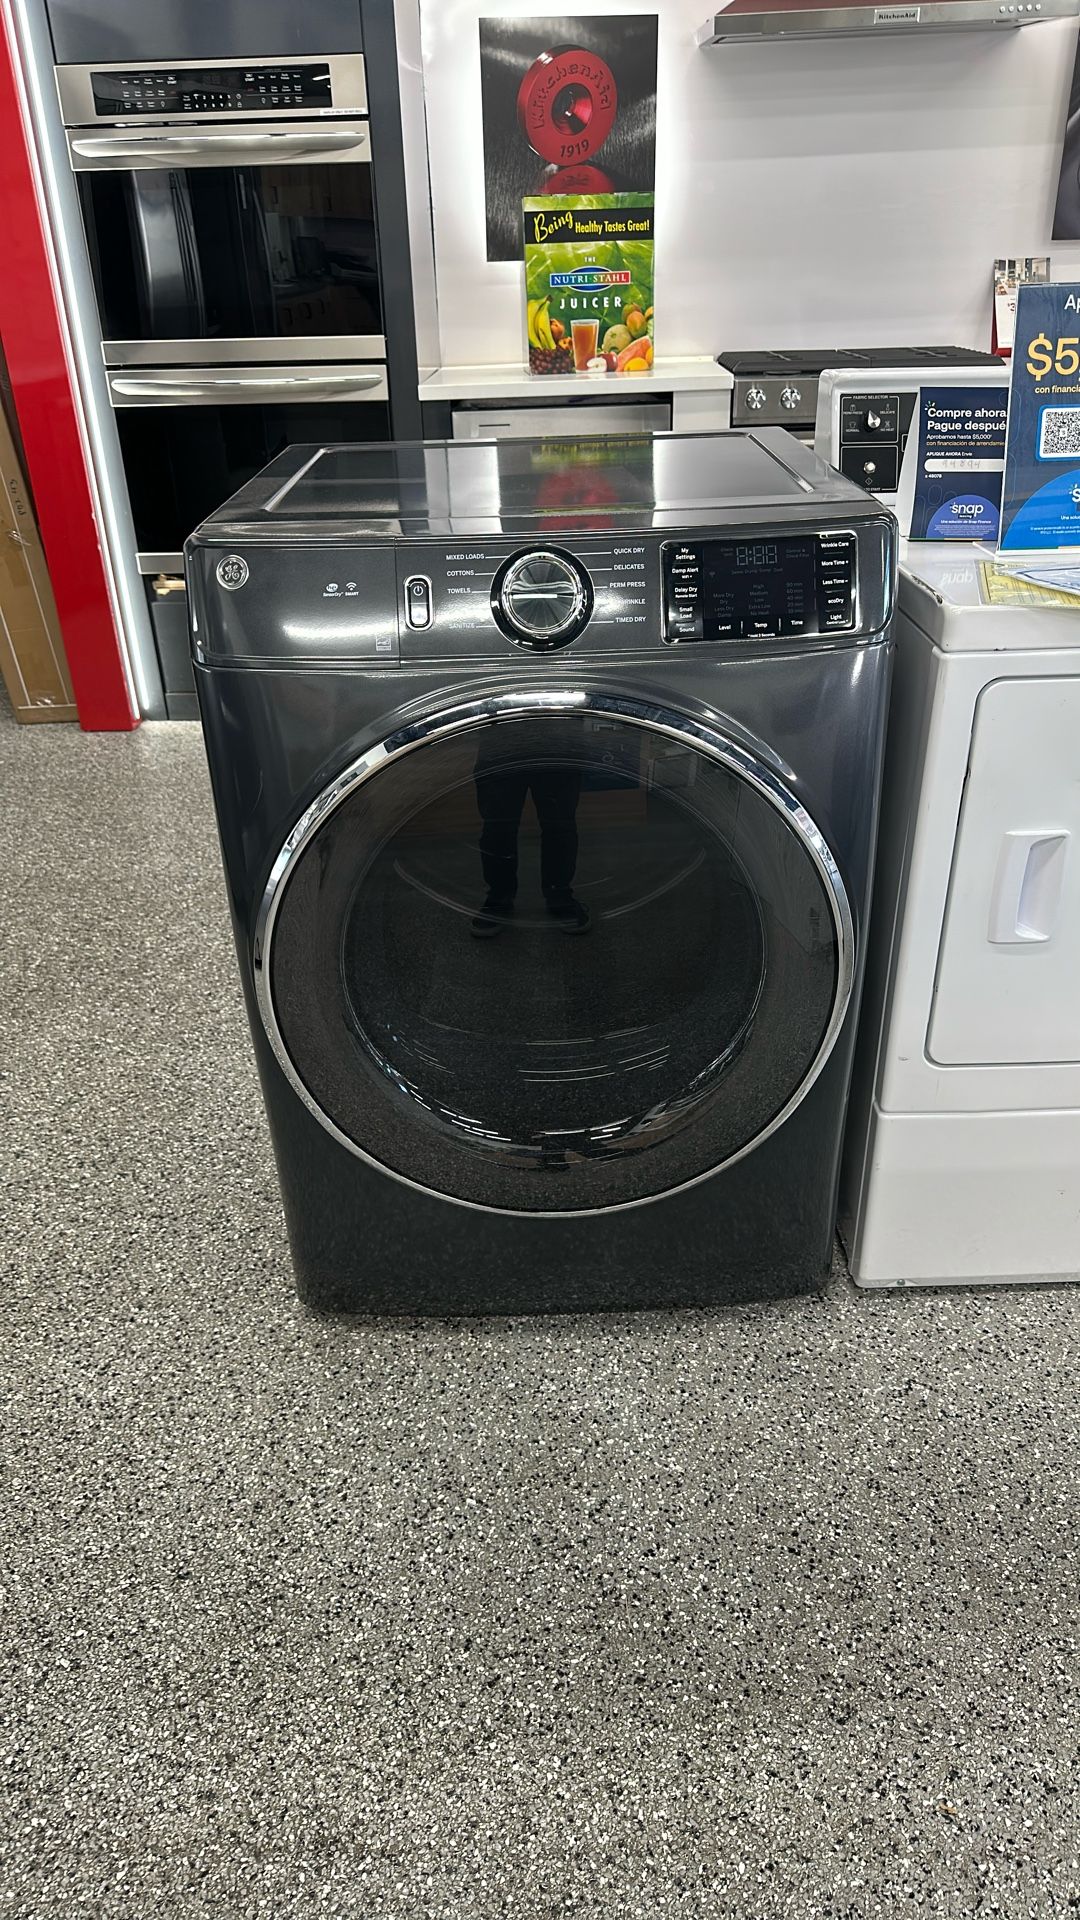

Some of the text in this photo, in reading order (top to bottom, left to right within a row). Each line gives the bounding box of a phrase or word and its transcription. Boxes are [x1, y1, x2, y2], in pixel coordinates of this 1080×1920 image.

[878, 12, 916, 20] KitchenAid
[560, 139, 589, 157] 1919
[534, 211, 573, 242] Being
[575, 219, 650, 235] Healthy Tastes Great!
[560, 297, 622, 309] JUICER
[927, 407, 972, 419] Compre
[927, 421, 962, 432] Pague
[951, 503, 984, 517] snap
